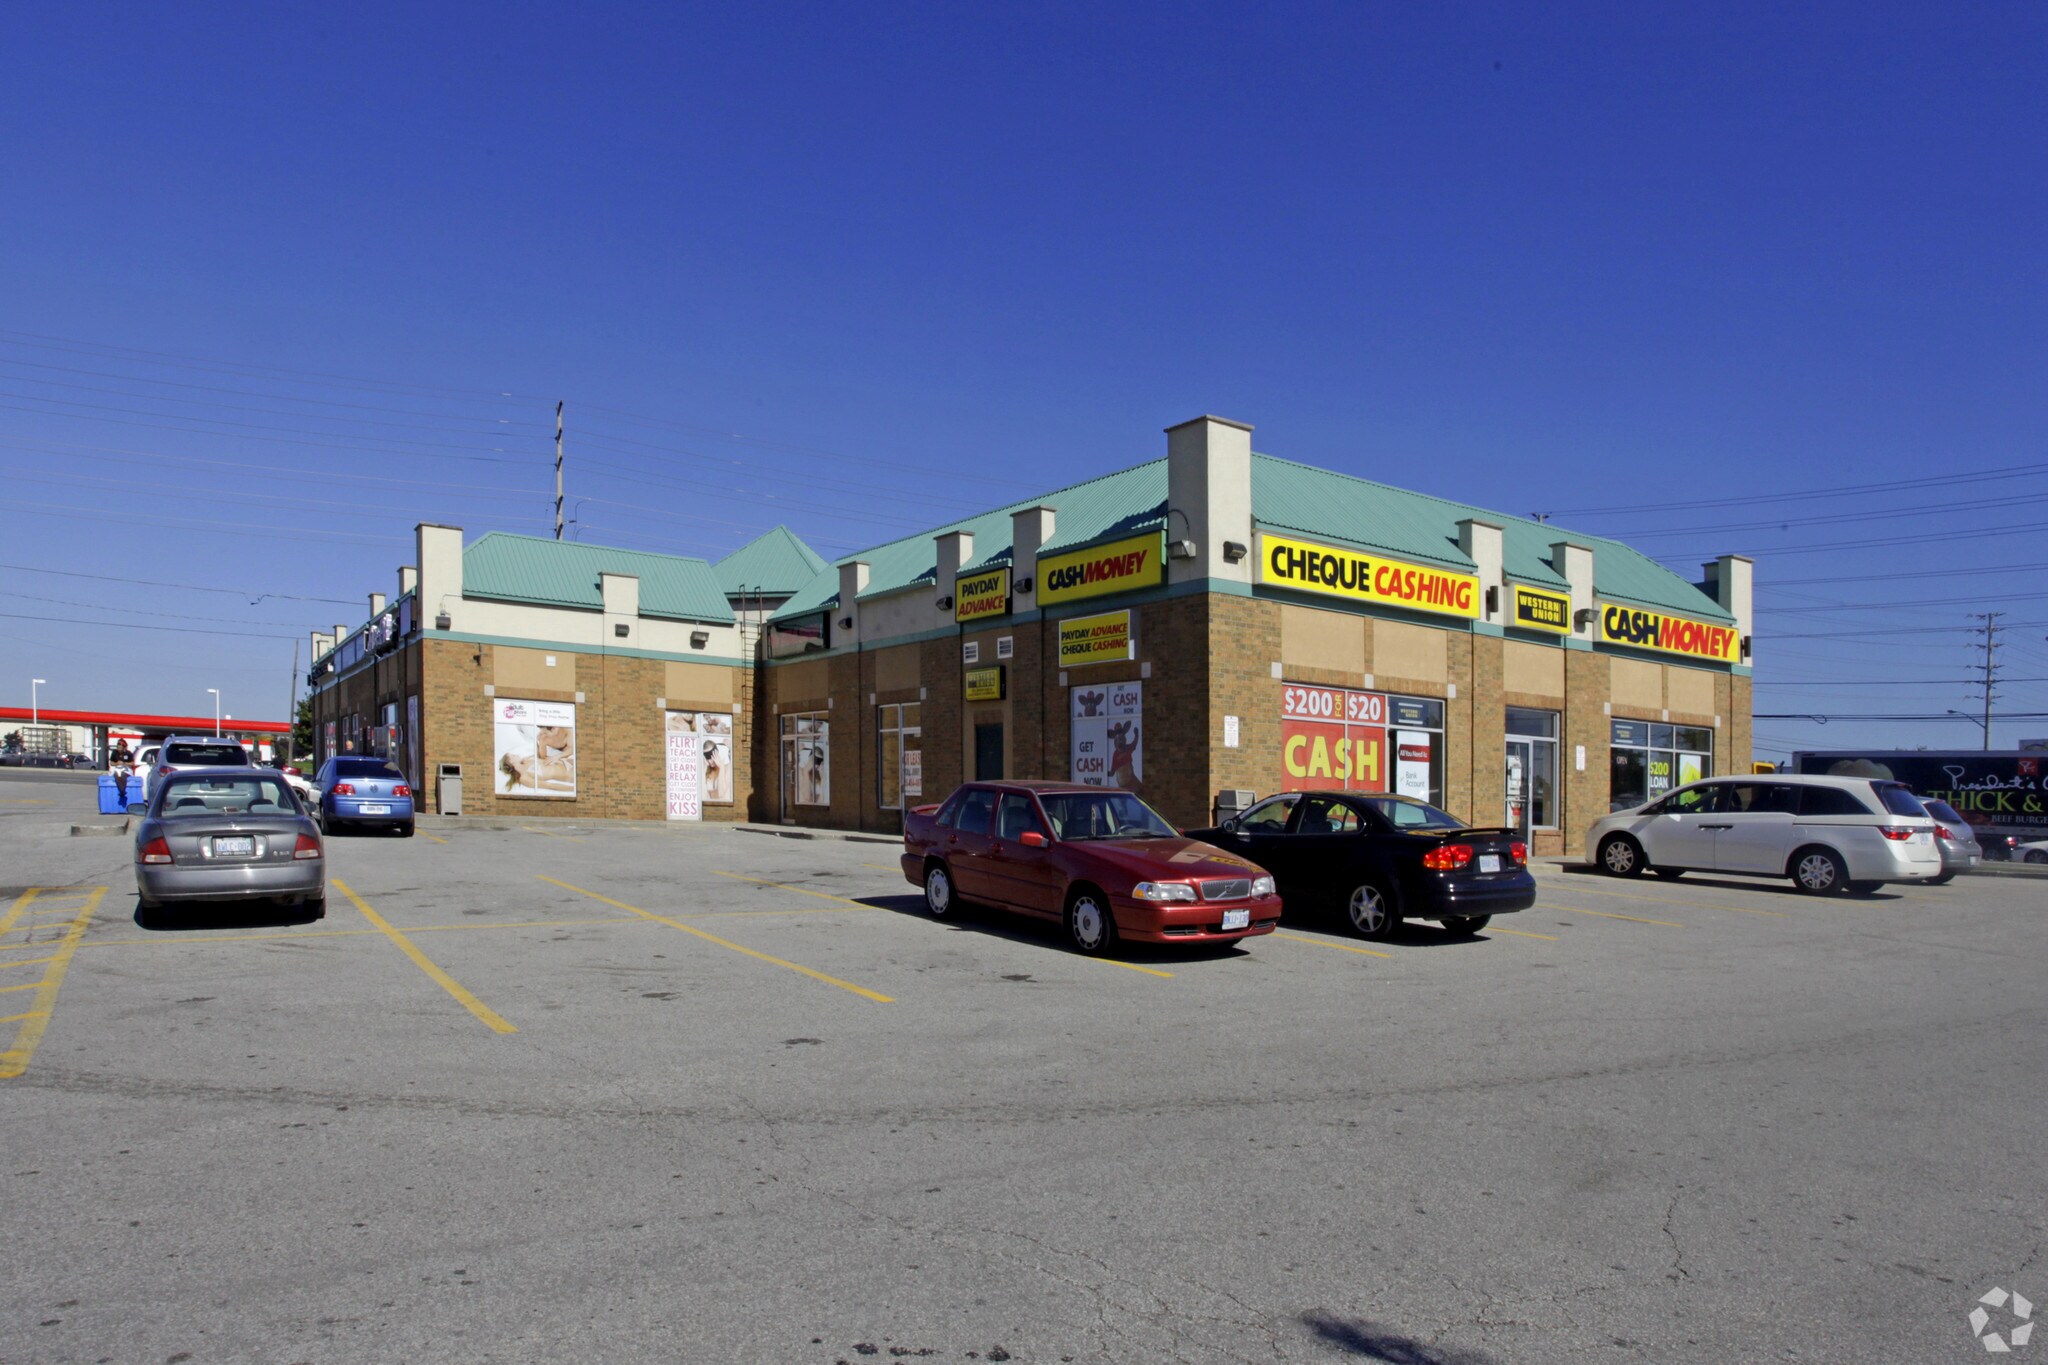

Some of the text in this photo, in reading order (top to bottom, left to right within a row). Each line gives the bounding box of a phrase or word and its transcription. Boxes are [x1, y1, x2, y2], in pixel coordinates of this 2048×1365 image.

[1048, 549, 1147, 591] CASHMONEY
[1271, 545, 1472, 609] CHEQUE CASHING
[962, 576, 999, 597] PAYDAY
[958, 595, 1004, 616] ADVANCE
[1519, 594, 1559, 612] WESTERN
[1532, 608, 1559, 623] UNION
[1061, 622, 1127, 641] PAYDAY ADVANCE
[1604, 606, 1735, 658] CASHMONEY
[1062, 637, 1127, 655] CHEQUE CASHING
[1113, 692, 1138, 707] CASH
[1285, 688, 1381, 721] $200 FOR $20
[669, 736, 696, 748] FLIRT
[1079, 741, 1094, 752] GET
[670, 749, 697, 757] TEACH
[1284, 734, 1378, 782] CASH
[669, 763, 697, 772] LEARN
[1076, 758, 1104, 773] CASH
[1649, 762, 1669, 776] $200
[669, 772, 697, 781] RELAX
[1405, 771, 1417, 780] Bank
[1649, 777, 1669, 789] LOAN
[1405, 779, 1425, 788] Account
[669, 793, 697, 801] ENJOY
[1926, 790, 2044, 812] THICK &
[669, 801, 698, 815] KISS
[1991, 814, 2014, 823] BEEF
